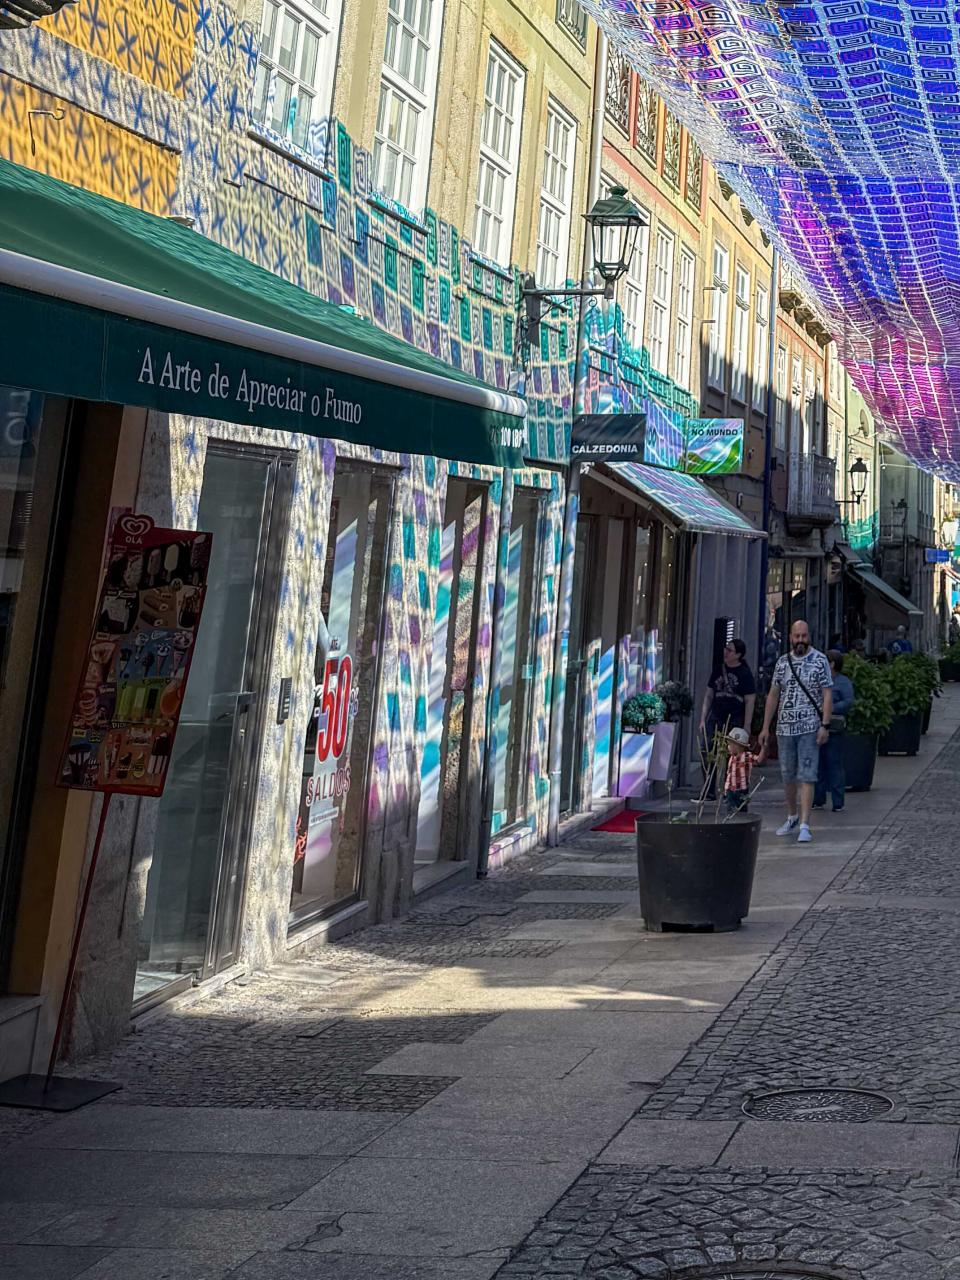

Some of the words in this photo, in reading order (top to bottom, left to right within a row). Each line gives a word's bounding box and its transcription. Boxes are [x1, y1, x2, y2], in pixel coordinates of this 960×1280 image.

[138, 347, 154, 384] A
[159, 352, 201, 393] Arte
[208, 363, 230, 399] de
[236, 369, 307, 413] Apreciar
[311, 395, 320, 417] o
[324, 388, 362, 424] Fumo
[572, 444, 638, 455] CALZEDONIA
[306, 767, 352, 808] SALDOS
